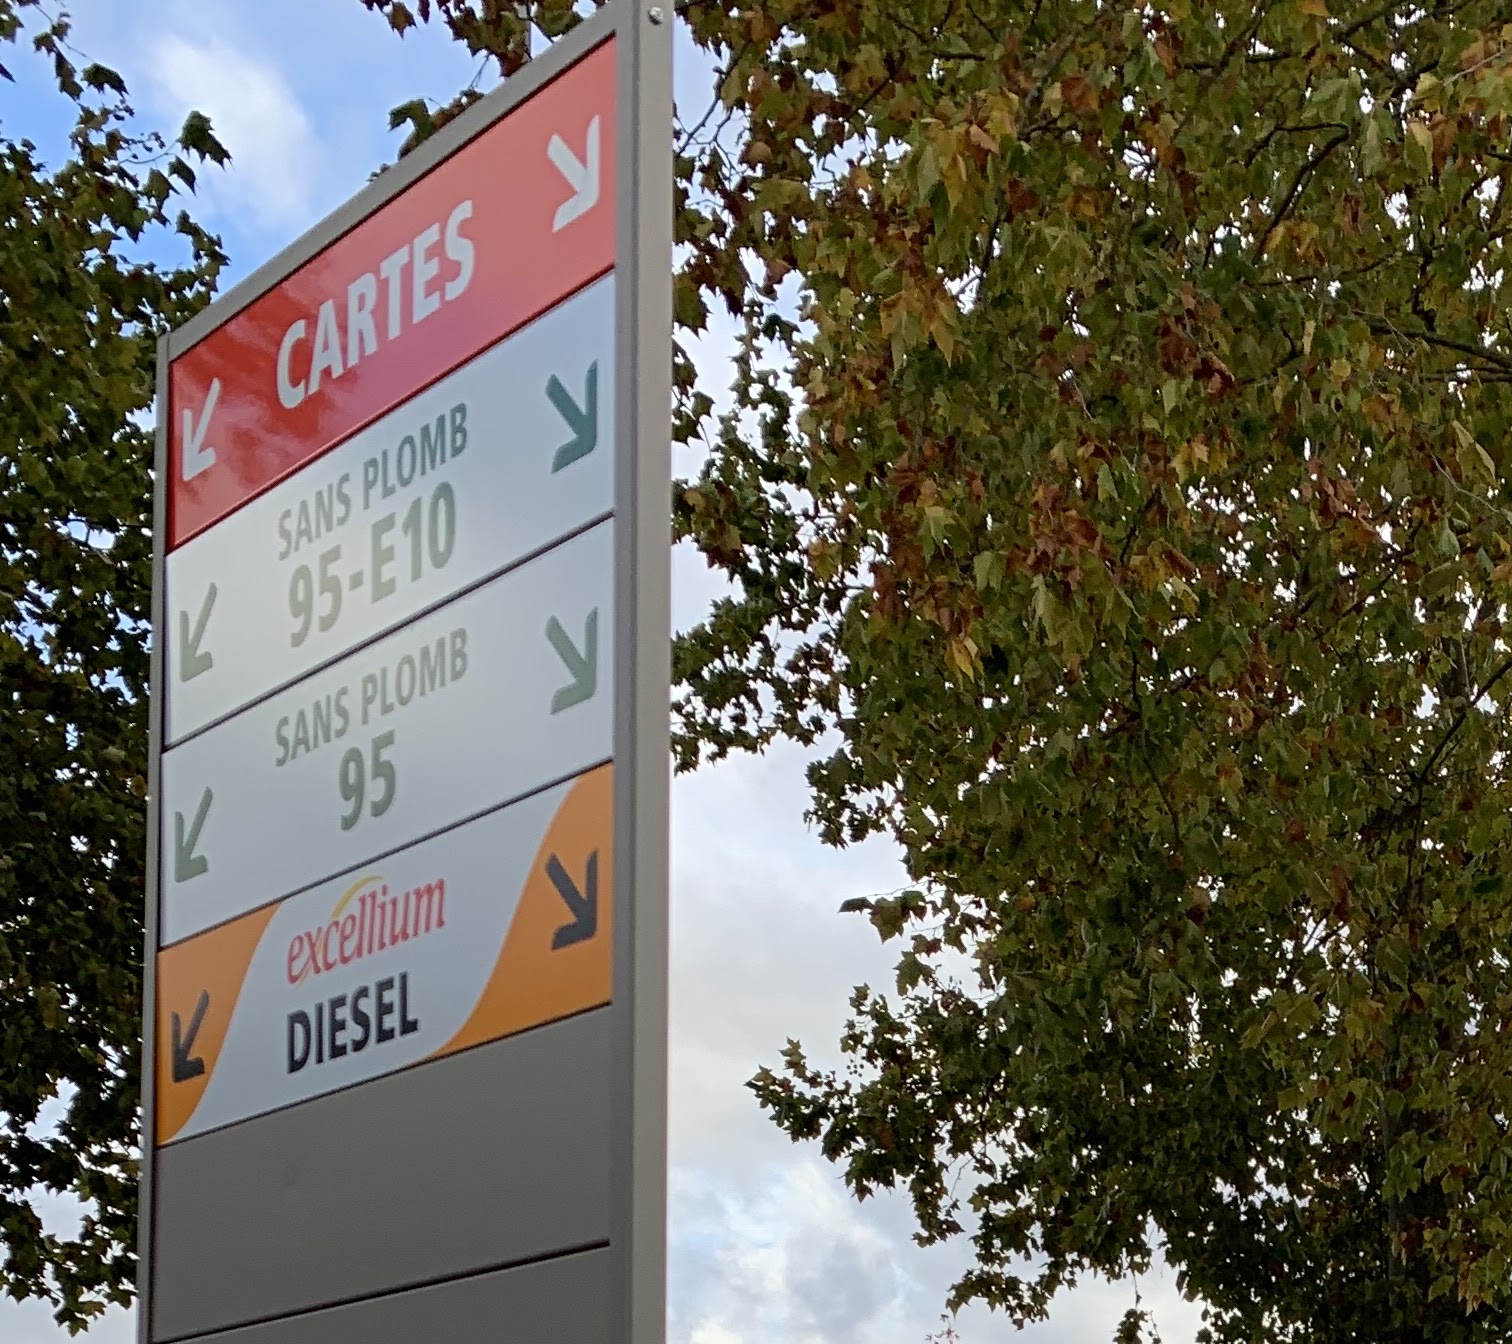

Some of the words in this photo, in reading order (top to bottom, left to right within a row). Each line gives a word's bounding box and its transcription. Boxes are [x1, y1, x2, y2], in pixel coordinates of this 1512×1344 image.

[276, 200, 475, 409] CARTES
[277, 473, 351, 561] SANS
[362, 402, 467, 511] PLOMB
[288, 481, 455, 647] 95-E10
[275, 686, 349, 767] SANS
[361, 627, 468, 725] PLOMB
[338, 730, 396, 831] 95
[287, 877, 446, 985] excellium
[286, 970, 419, 1074] DIESEL
